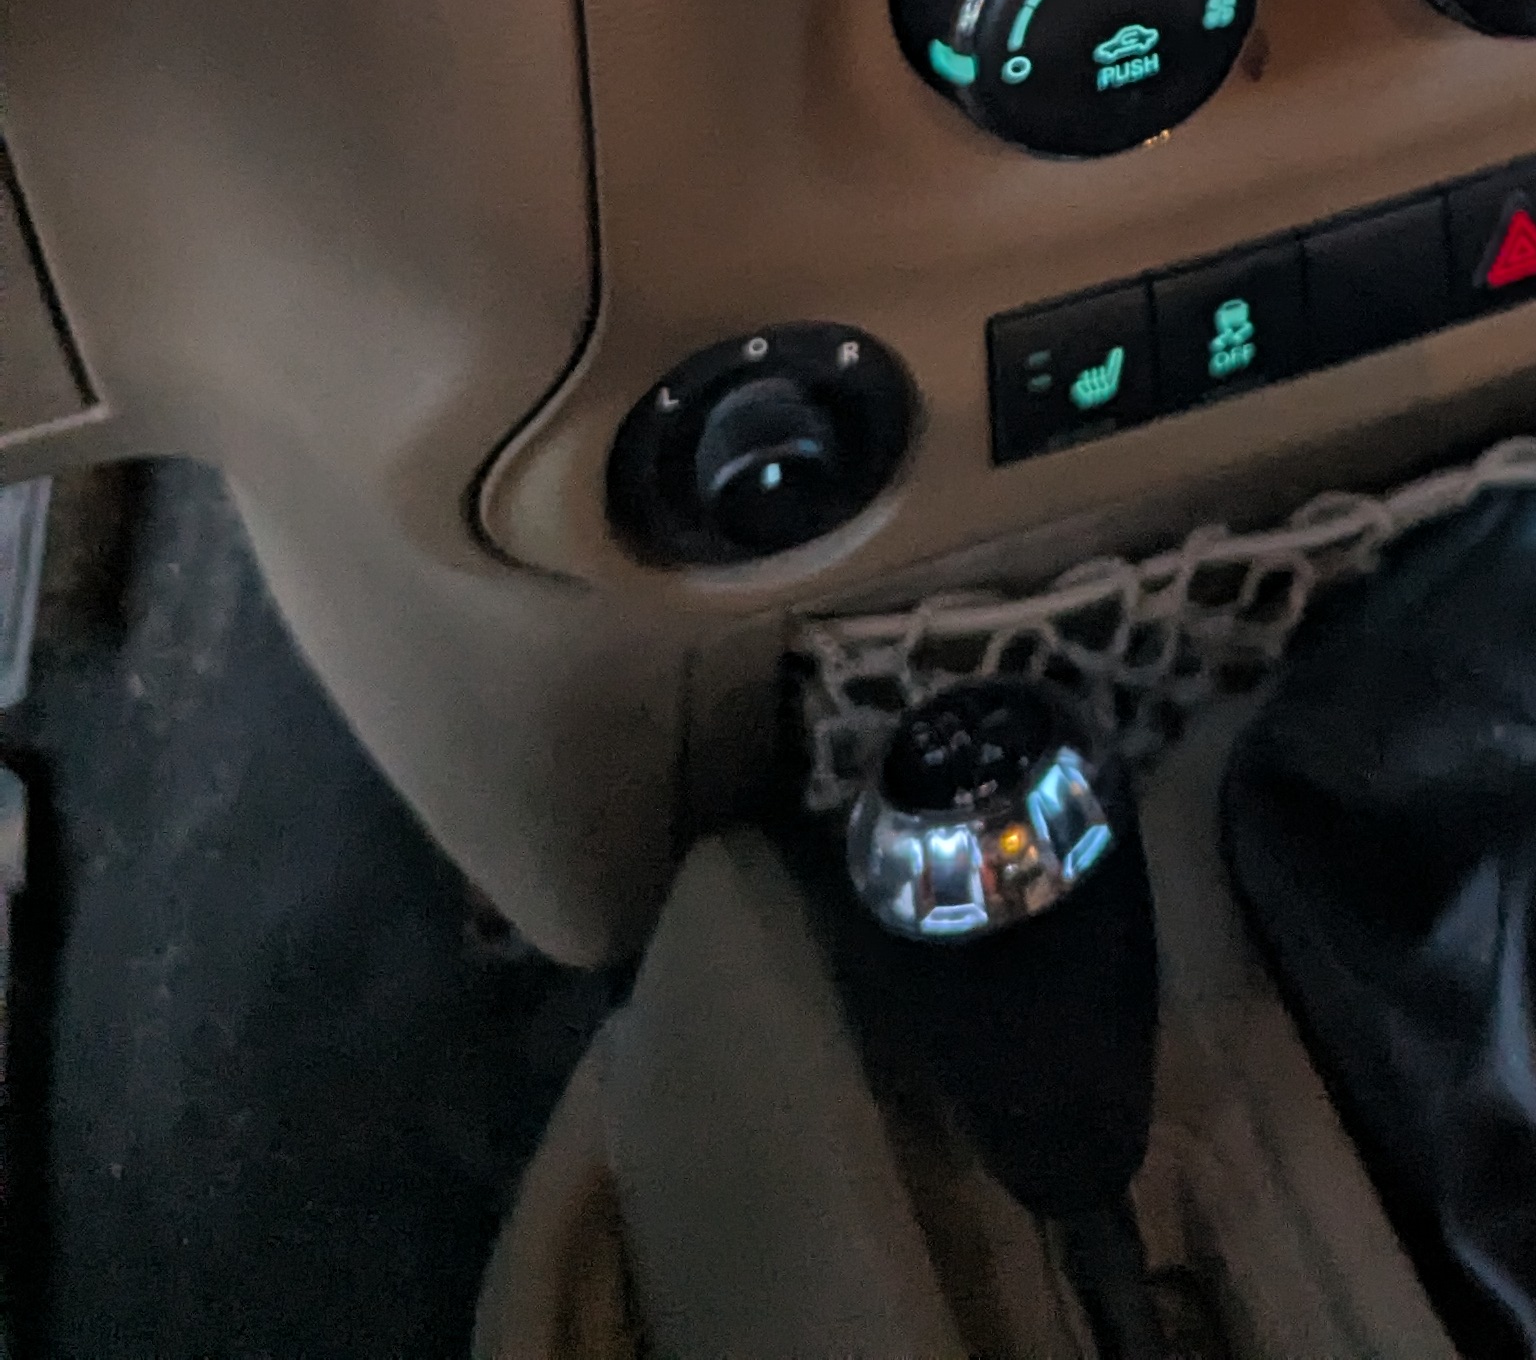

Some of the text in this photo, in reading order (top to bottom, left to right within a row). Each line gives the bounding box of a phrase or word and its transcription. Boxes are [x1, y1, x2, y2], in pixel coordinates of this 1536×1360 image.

[1097, 53, 1160, 90] PUSH
[840, 340, 861, 366] R
[1208, 343, 1257, 377] OFF
[660, 387, 680, 410] L
